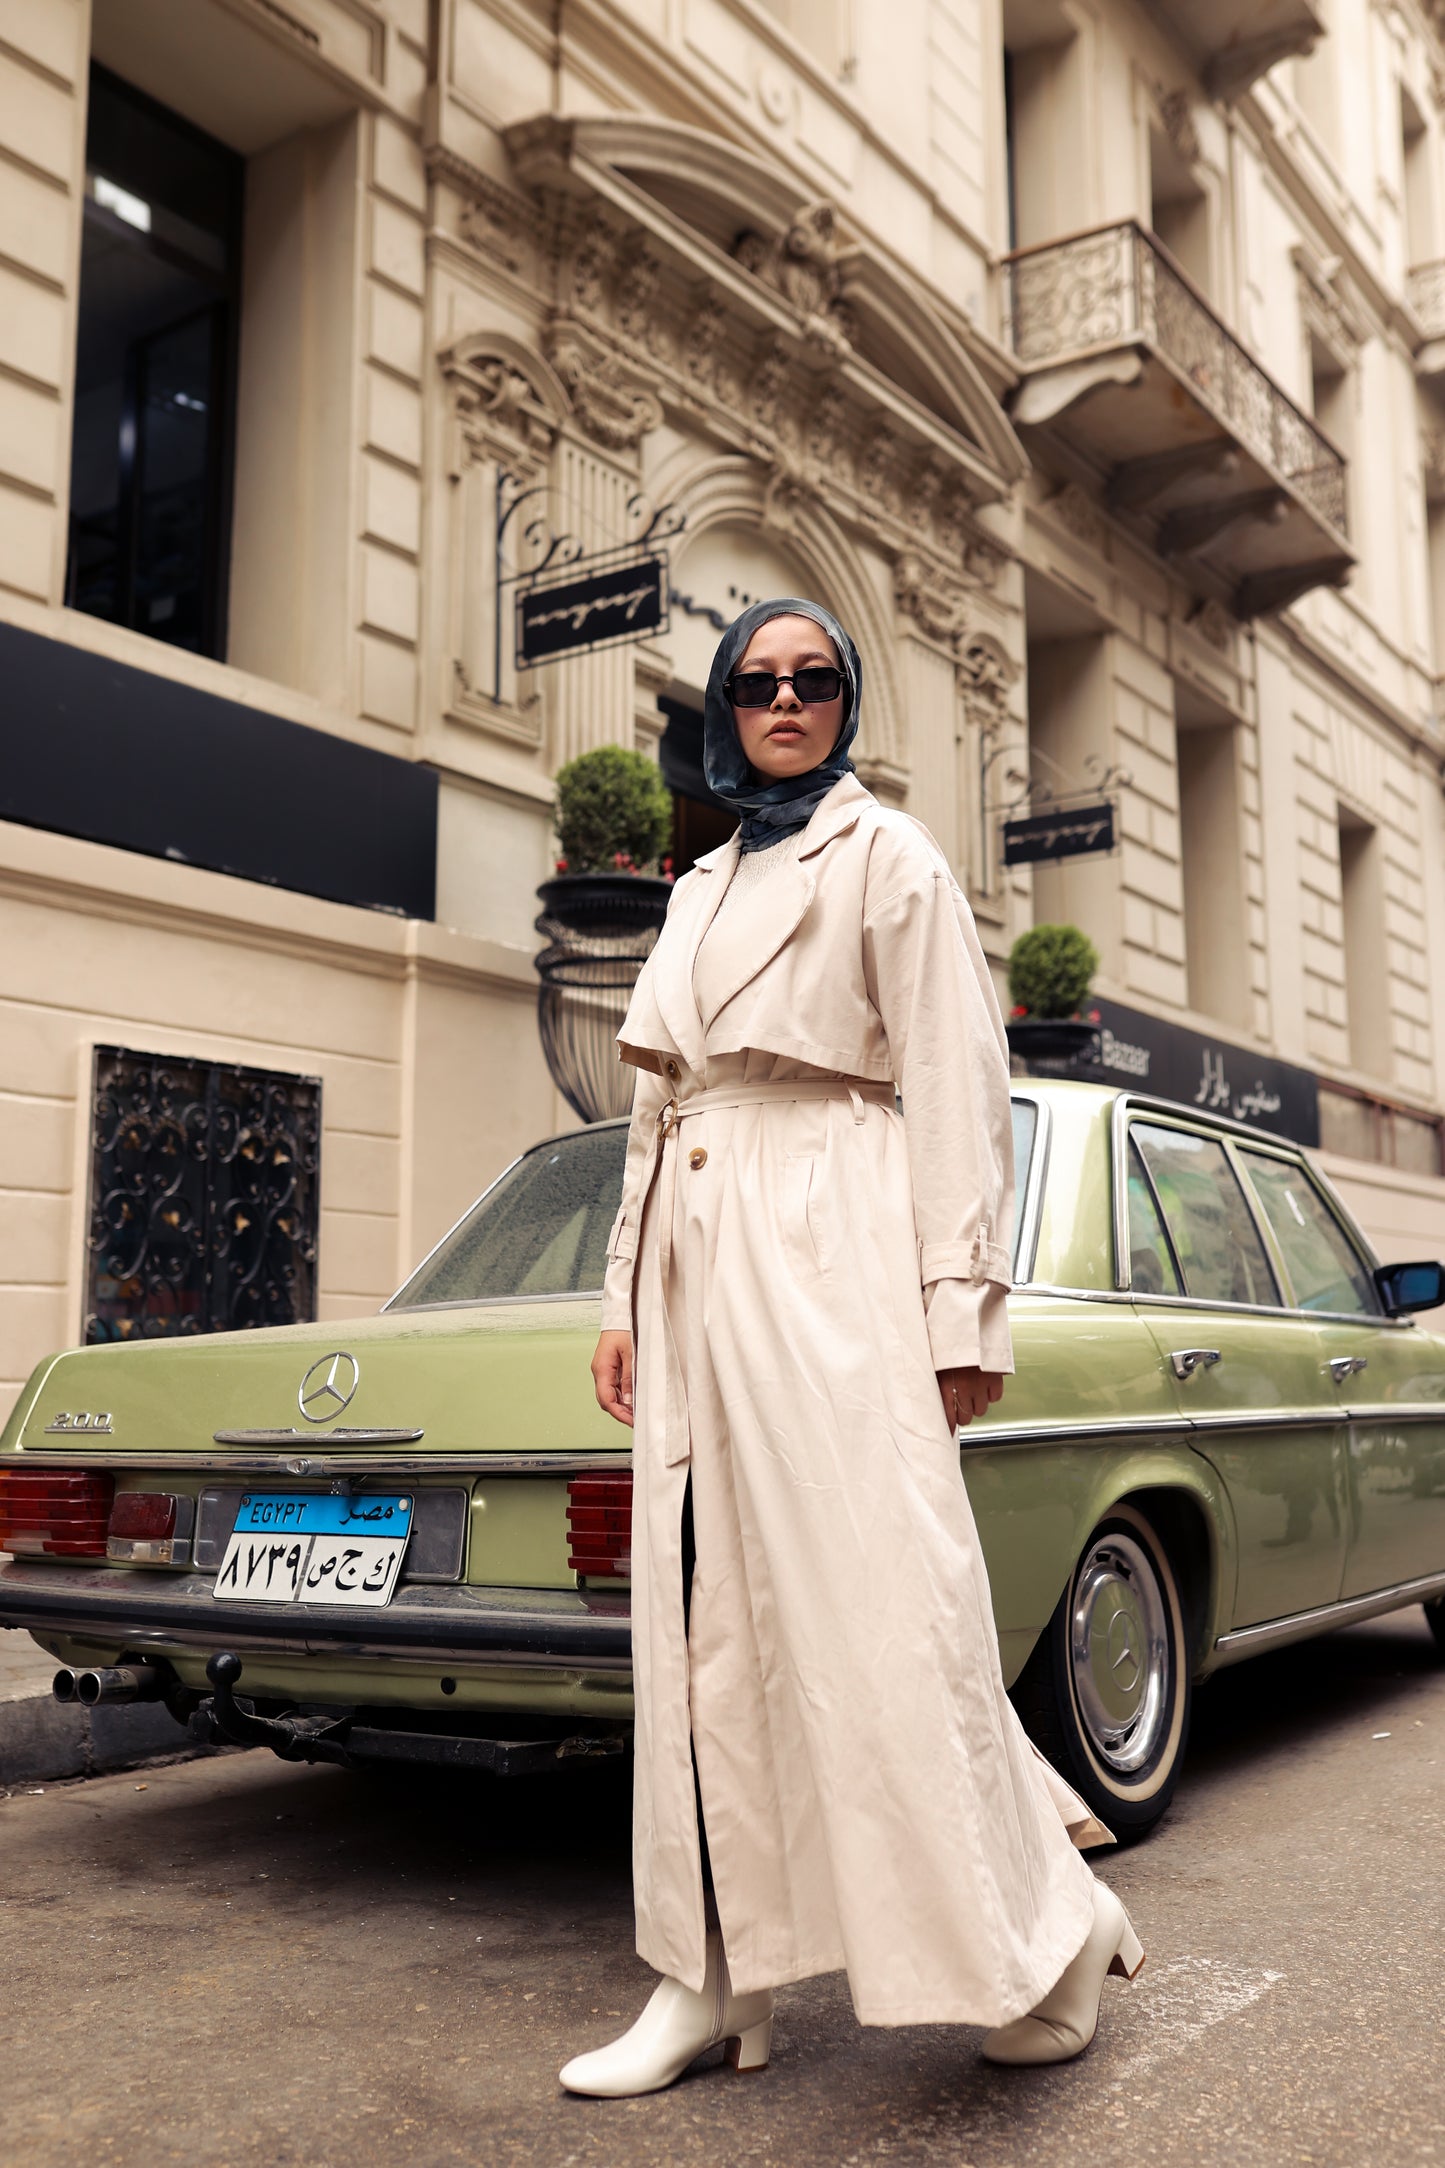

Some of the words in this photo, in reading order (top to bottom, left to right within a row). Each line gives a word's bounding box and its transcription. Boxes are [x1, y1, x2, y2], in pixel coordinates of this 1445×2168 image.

[1101, 1029, 1150, 1077] Bazaar
[1194, 1048, 1230, 1108] بازار
[52, 1412, 112, 1429] 200
[250, 1502, 309, 1524] EGYPT
[339, 1504, 395, 1525] مصر
[220, 1542, 302, 1591] ٨٧٣٩
